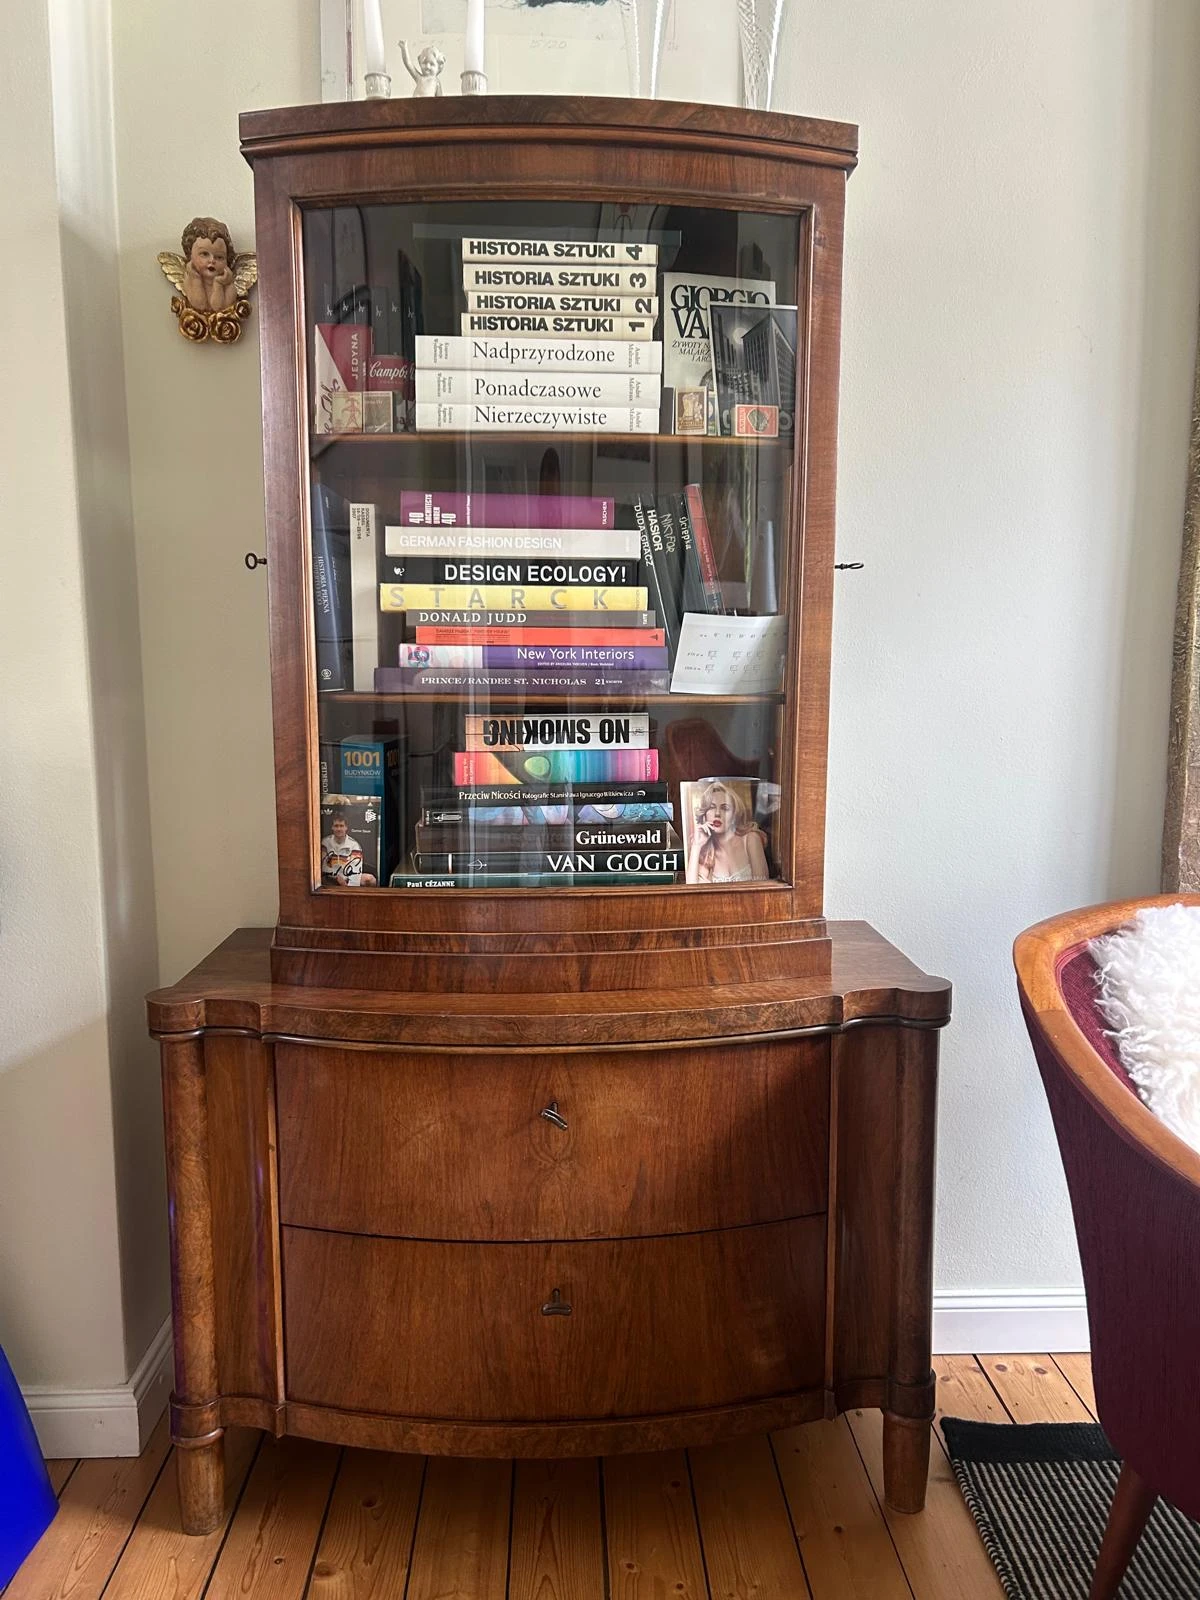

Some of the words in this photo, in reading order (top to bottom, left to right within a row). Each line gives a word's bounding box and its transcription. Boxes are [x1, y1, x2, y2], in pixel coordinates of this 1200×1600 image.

[469, 241, 549, 256] HISTORIA
[553, 243, 615, 258] SZTUKI
[625, 245, 642, 260] 4
[475, 271, 554, 285] HISTORIA
[558, 272, 620, 286] SZTUKI
[629, 273, 646, 288] 3
[476, 295, 556, 310] HISTORIA
[560, 297, 621, 312] SZTUKI
[635, 298, 651, 313] 2
[470, 316, 549, 331] HISTORIA
[552, 317, 614, 332] SZTUKI
[628, 322, 645, 332] 1
[671, 307, 710, 340] VA
[351, 332, 359, 380] JEDYNA
[472, 341, 615, 365] Nadprzyrodzone
[679, 348, 711, 356] MALARZ
[474, 378, 602, 398] Ponadczasowe
[474, 405, 607, 429] Nierzeczywiste
[409, 512, 424, 524] 40
[424, 494, 432, 525] ARCHITECTS
[441, 513, 456, 525] 40
[634, 504, 654, 567] DUDA-GRACZ
[647, 509, 663, 552] HASIOR
[400, 535, 456, 548] GERMAN
[458, 536, 513, 549] FASHION
[514, 536, 562, 549] DESIGN
[444, 564, 521, 582] DESIGN
[527, 565, 626, 583] ECOLOGY!
[390, 586, 609, 610] STARCK
[419, 612, 481, 623] DONALD
[486, 613, 527, 625] JUDD
[517, 648, 546, 660] New
[550, 648, 577, 660] York
[581, 648, 635, 660] Interiors
[514, 677, 529, 685] ST.
[532, 678, 587, 686] NICHOLAS
[595, 678, 605, 686] 21
[483, 719, 591, 747] SMOKING
[599, 718, 630, 744] NO
[343, 751, 380, 767] 1001
[321, 761, 329, 795] CUSKIEJ
[344, 768, 381, 776] BUDYNKÓW
[459, 791, 490, 800] Przeciw
[491, 790, 521, 800] Nicości
[580, 791, 604, 799] Ignacego
[575, 829, 661, 845] Grünewald
[546, 854, 596, 872] VAN
[606, 853, 678, 872] GOGH
[425, 880, 455, 888] CÉZANNE
